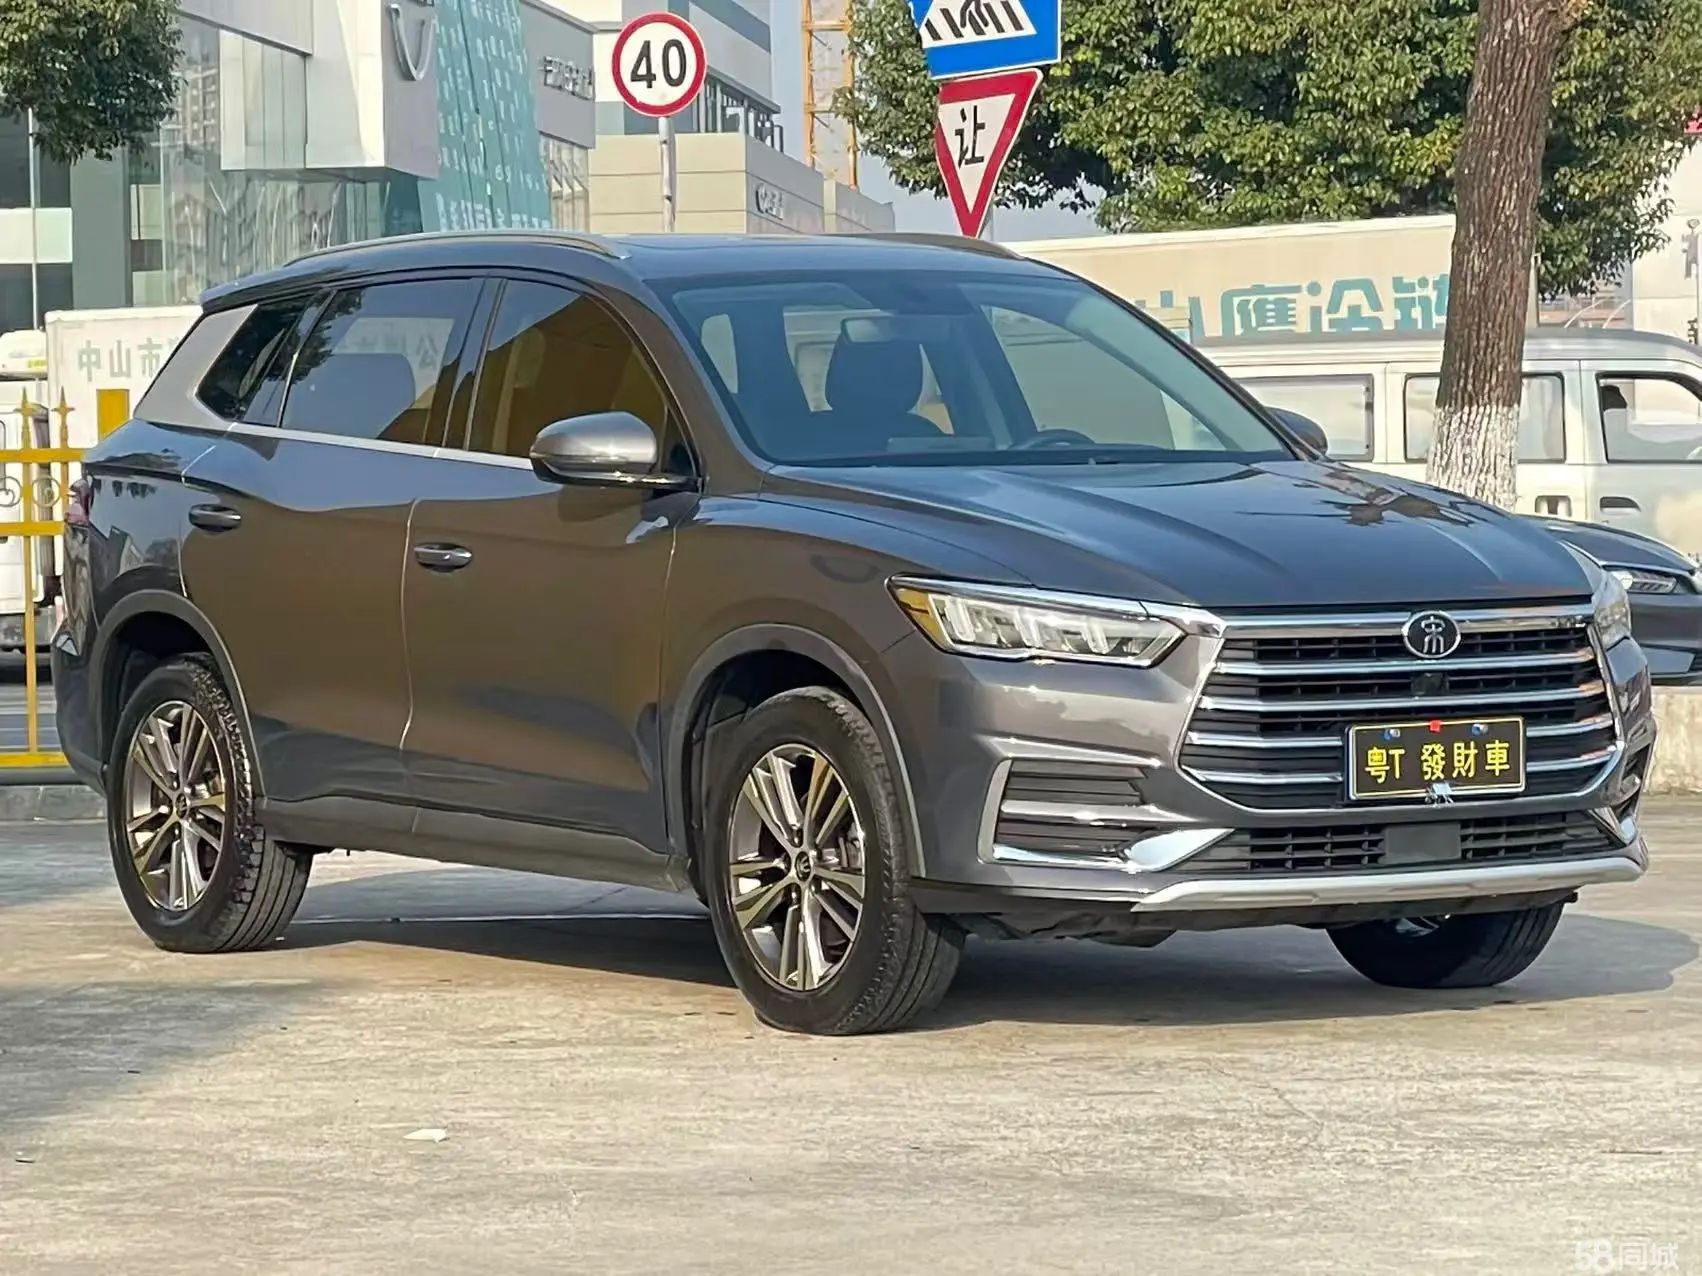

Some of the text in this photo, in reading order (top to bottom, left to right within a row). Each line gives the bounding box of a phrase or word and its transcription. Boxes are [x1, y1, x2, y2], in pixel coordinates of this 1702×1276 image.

[630, 39, 687, 88] 40
[954, 105, 986, 168] 让
[78, 337, 180, 381] 中山市
[1365, 740, 1510, 783] 粤T 發財車
